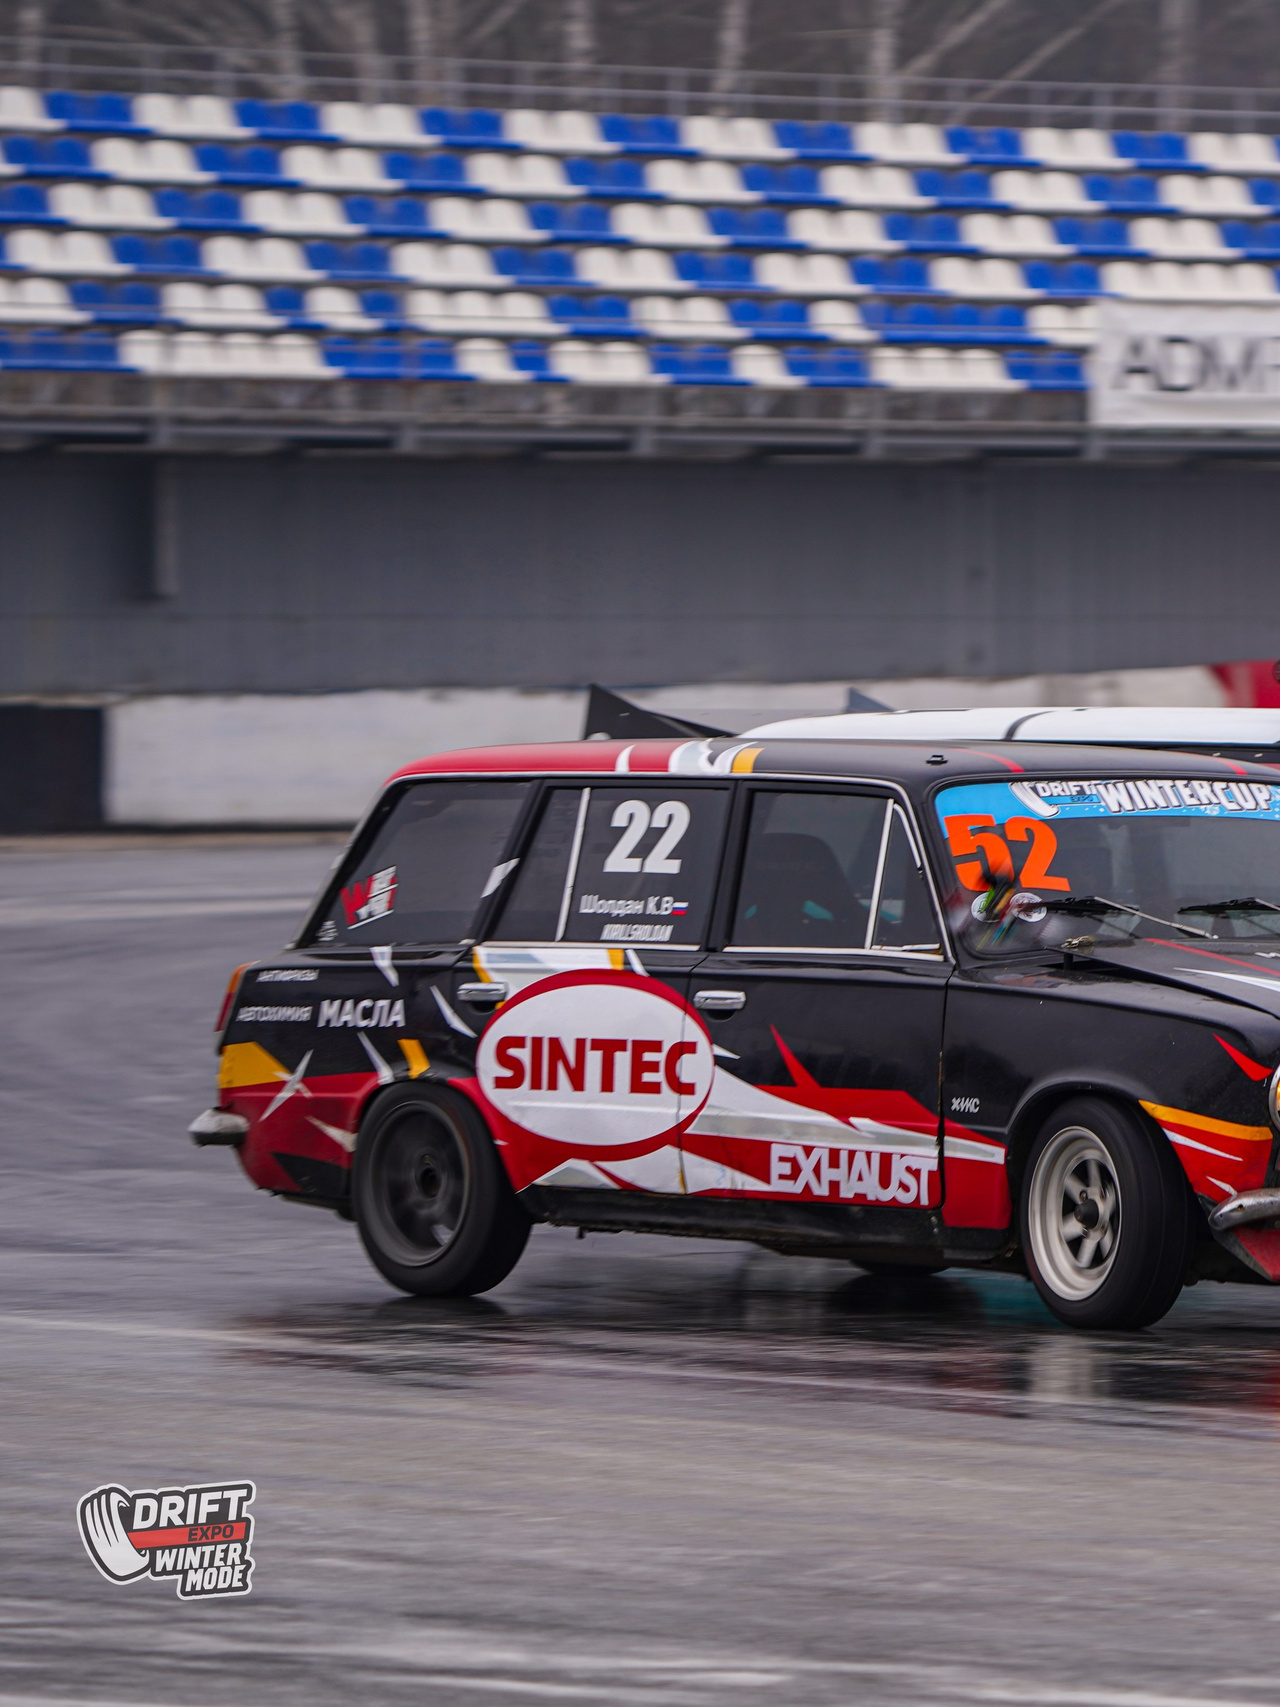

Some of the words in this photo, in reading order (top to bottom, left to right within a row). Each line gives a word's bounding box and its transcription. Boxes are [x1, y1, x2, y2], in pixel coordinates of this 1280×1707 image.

[604, 800, 691, 874] 22
[944, 814, 1071, 892] 52
[579, 894, 645, 917] Шолдан
[317, 998, 406, 1028] МАСЛА
[493, 1035, 698, 1096] SINTEC
[770, 1143, 938, 1206] EXHAUST
